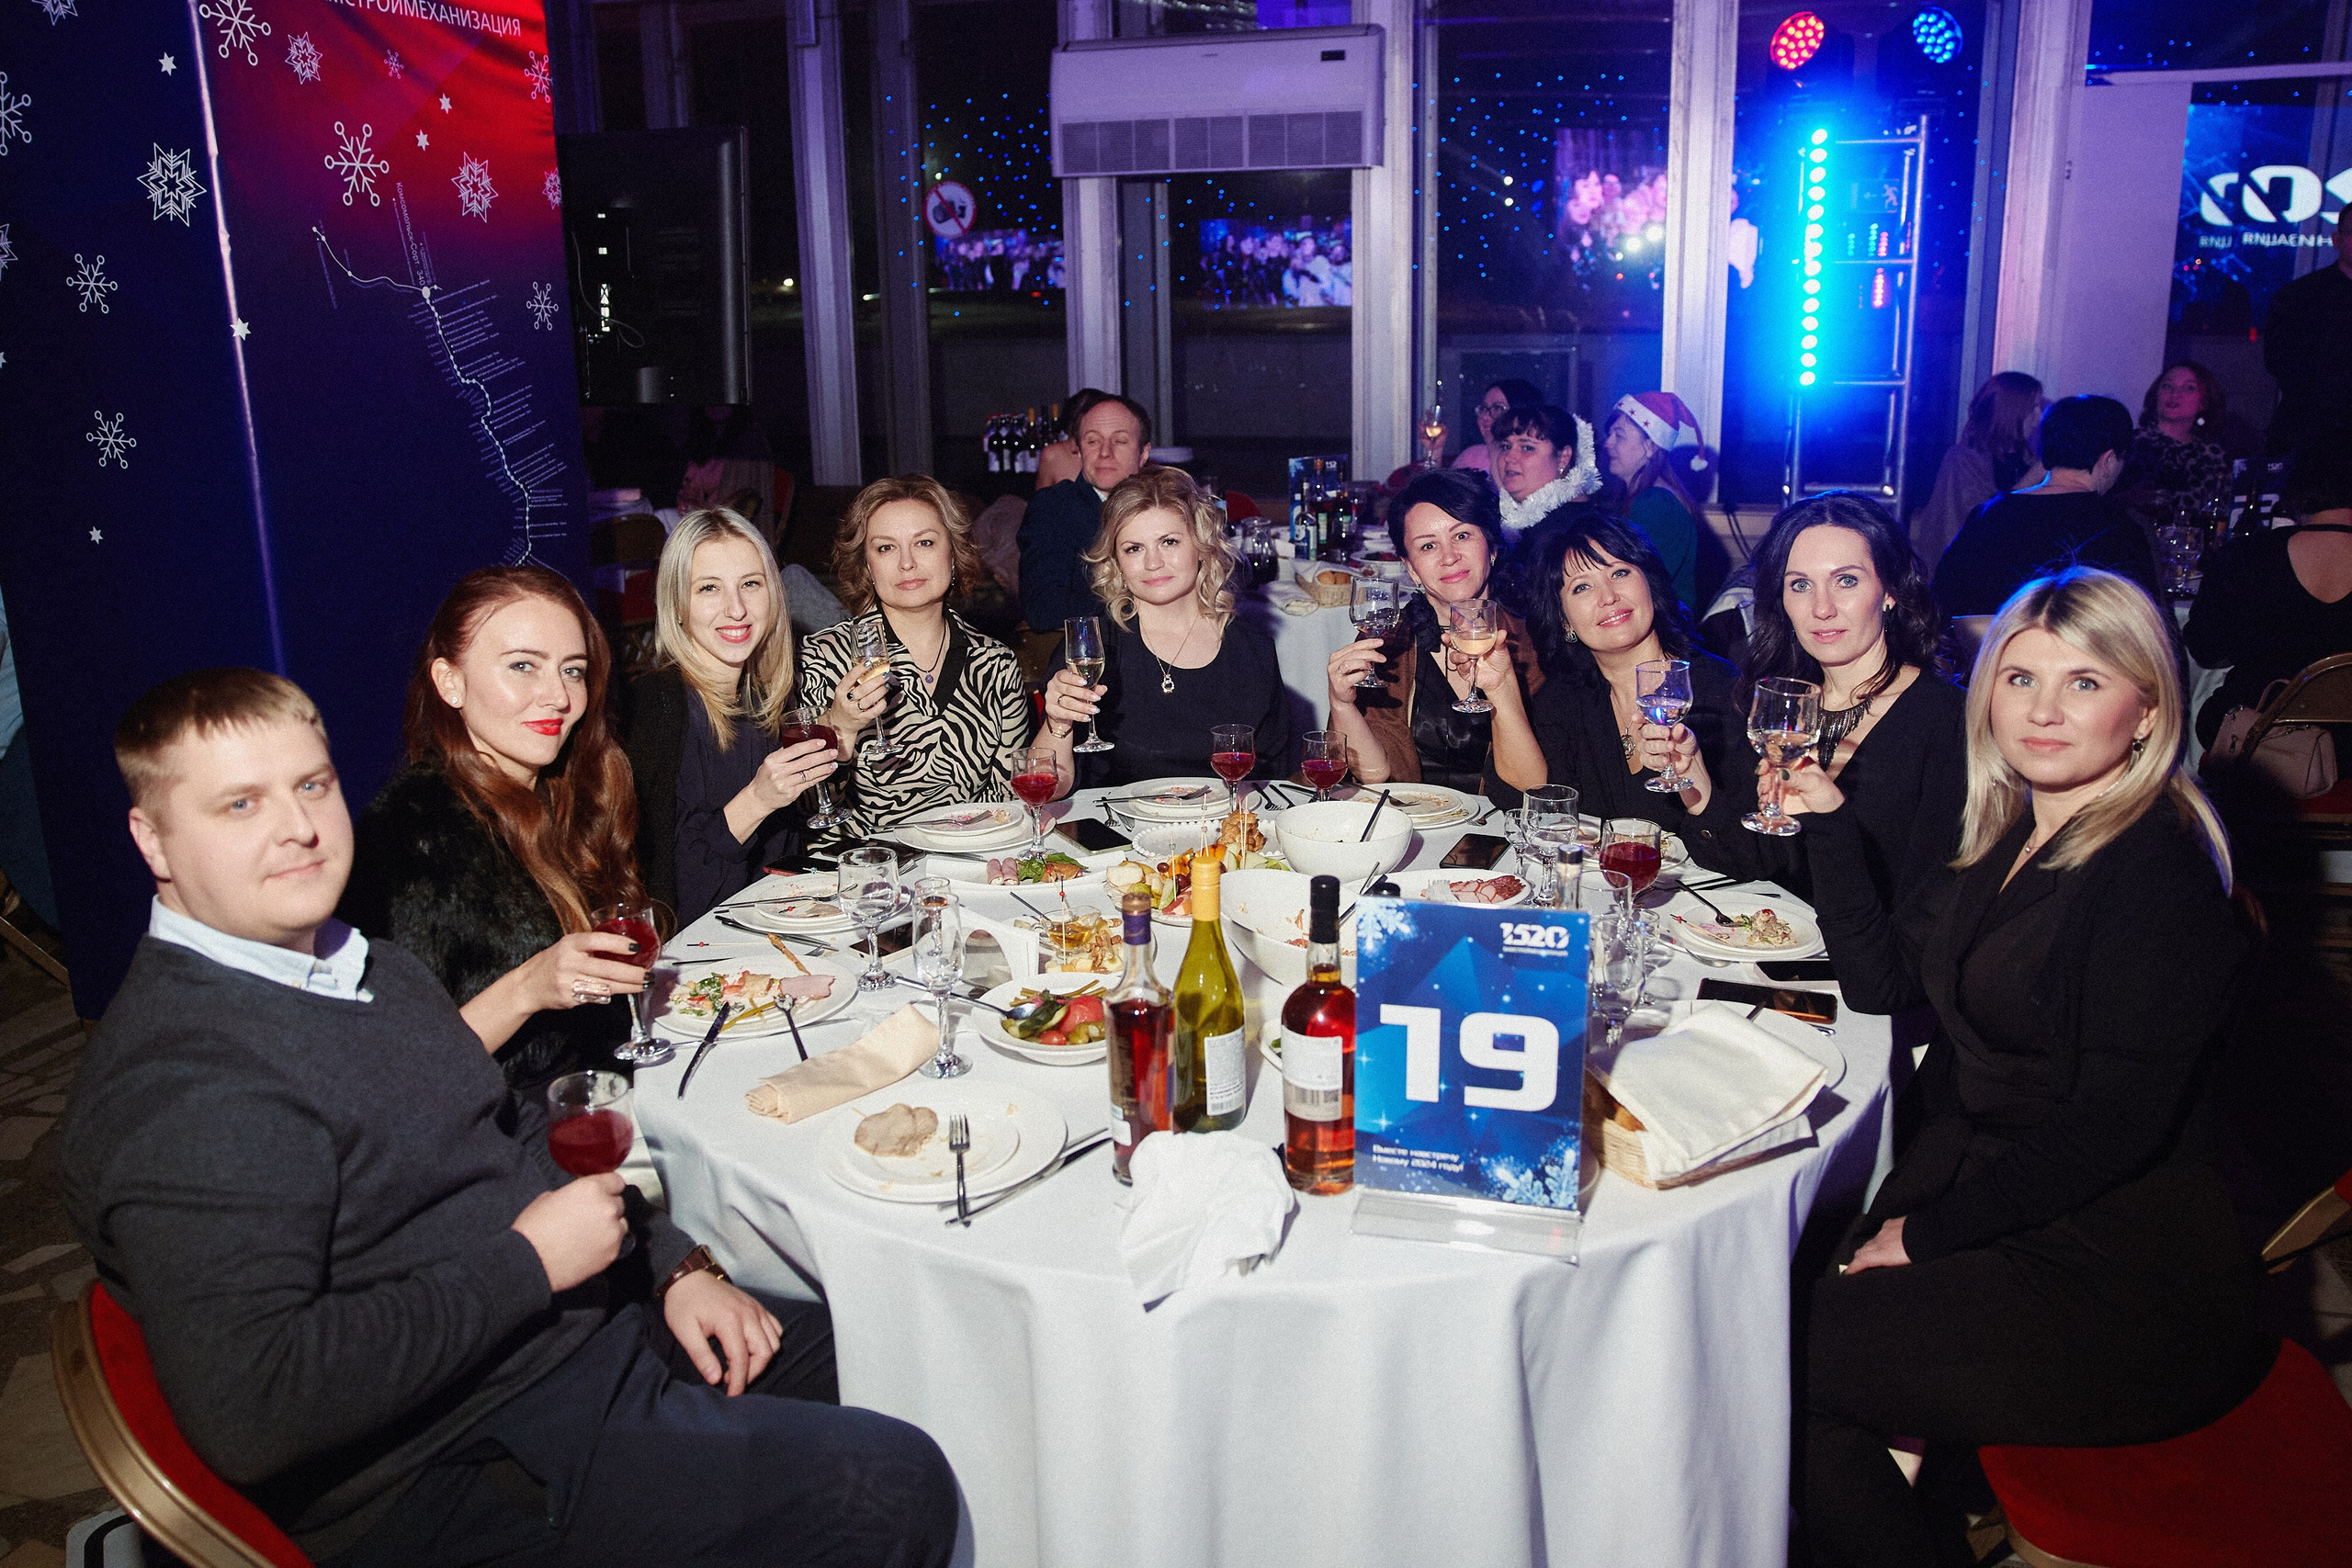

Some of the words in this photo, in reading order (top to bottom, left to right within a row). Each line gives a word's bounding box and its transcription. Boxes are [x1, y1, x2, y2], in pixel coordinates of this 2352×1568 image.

[1499, 922, 1570, 949] 1520
[1380, 1003, 1559, 1112] 19
[1372, 1154, 1409, 1168] Новому
[1410, 1157, 1437, 1169] 2024
[1438, 1161, 1464, 1174] году!
[1373, 1144, 1408, 1156] Вместе
[1409, 1149, 1460, 1164] навстречу
